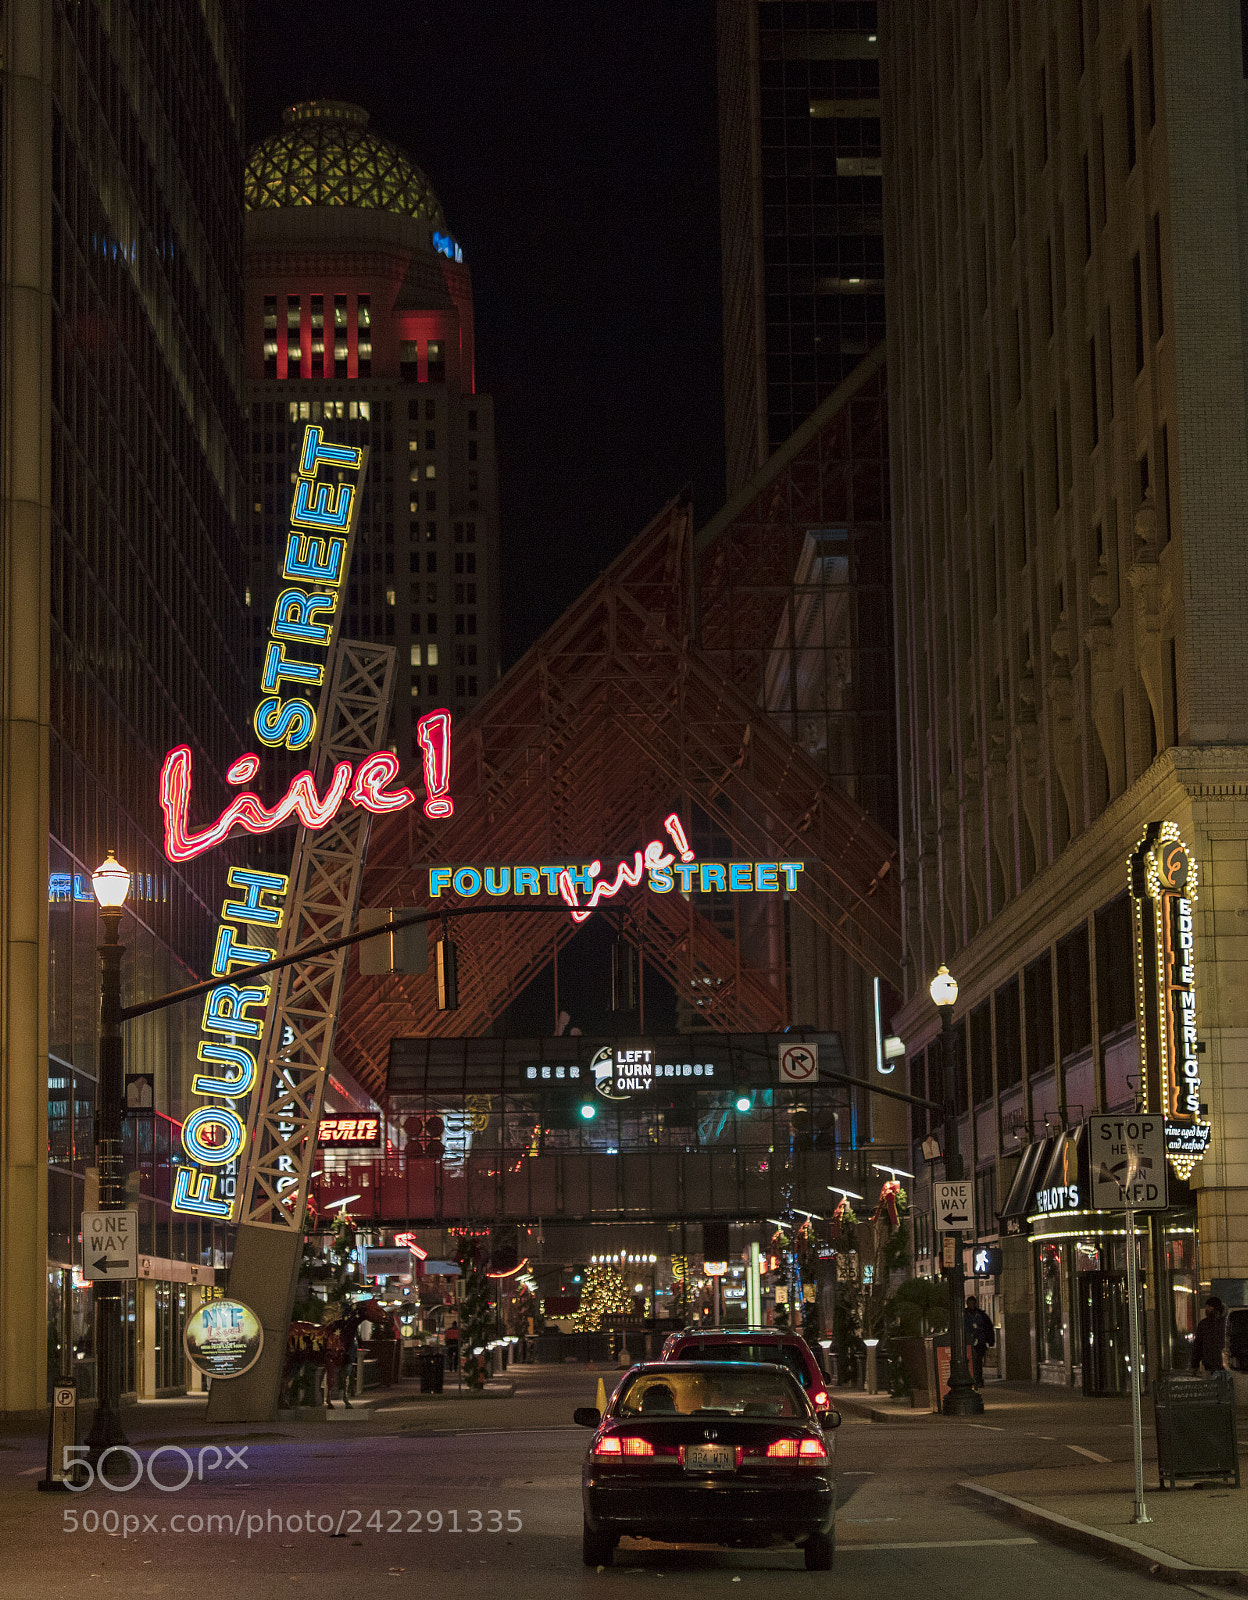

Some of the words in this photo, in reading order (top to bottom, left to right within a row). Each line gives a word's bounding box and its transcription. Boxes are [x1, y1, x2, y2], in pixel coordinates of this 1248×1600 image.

[159, 708, 454, 863] Live!
[171, 866, 289, 1220] FOURTH
[254, 425, 363, 751] STREET
[559, 813, 696, 923] Live!
[430, 866, 594, 898] FOURTH
[648, 862, 805, 894] STREET
[1180, 898, 1194, 984] EDDIE
[617, 1050, 652, 1063] LEFT
[526, 1066, 580, 1079] BEER
[655, 1064, 714, 1077] BRIDGE
[616, 1064, 652, 1077] TURN
[616, 1078, 652, 1090] ONLY
[1101, 1123, 1153, 1140] STOP
[1181, 1125, 1196, 1139] aged
[1196, 1125, 1211, 1139] beef
[1168, 1137, 1182, 1149] and
[1182, 1138, 1205, 1152] seafood
[941, 1185, 966, 1198] ONE
[940, 1199, 967, 1211] WAY
[92, 1217, 128, 1232] ONE
[91, 1236, 129, 1252] WAY
